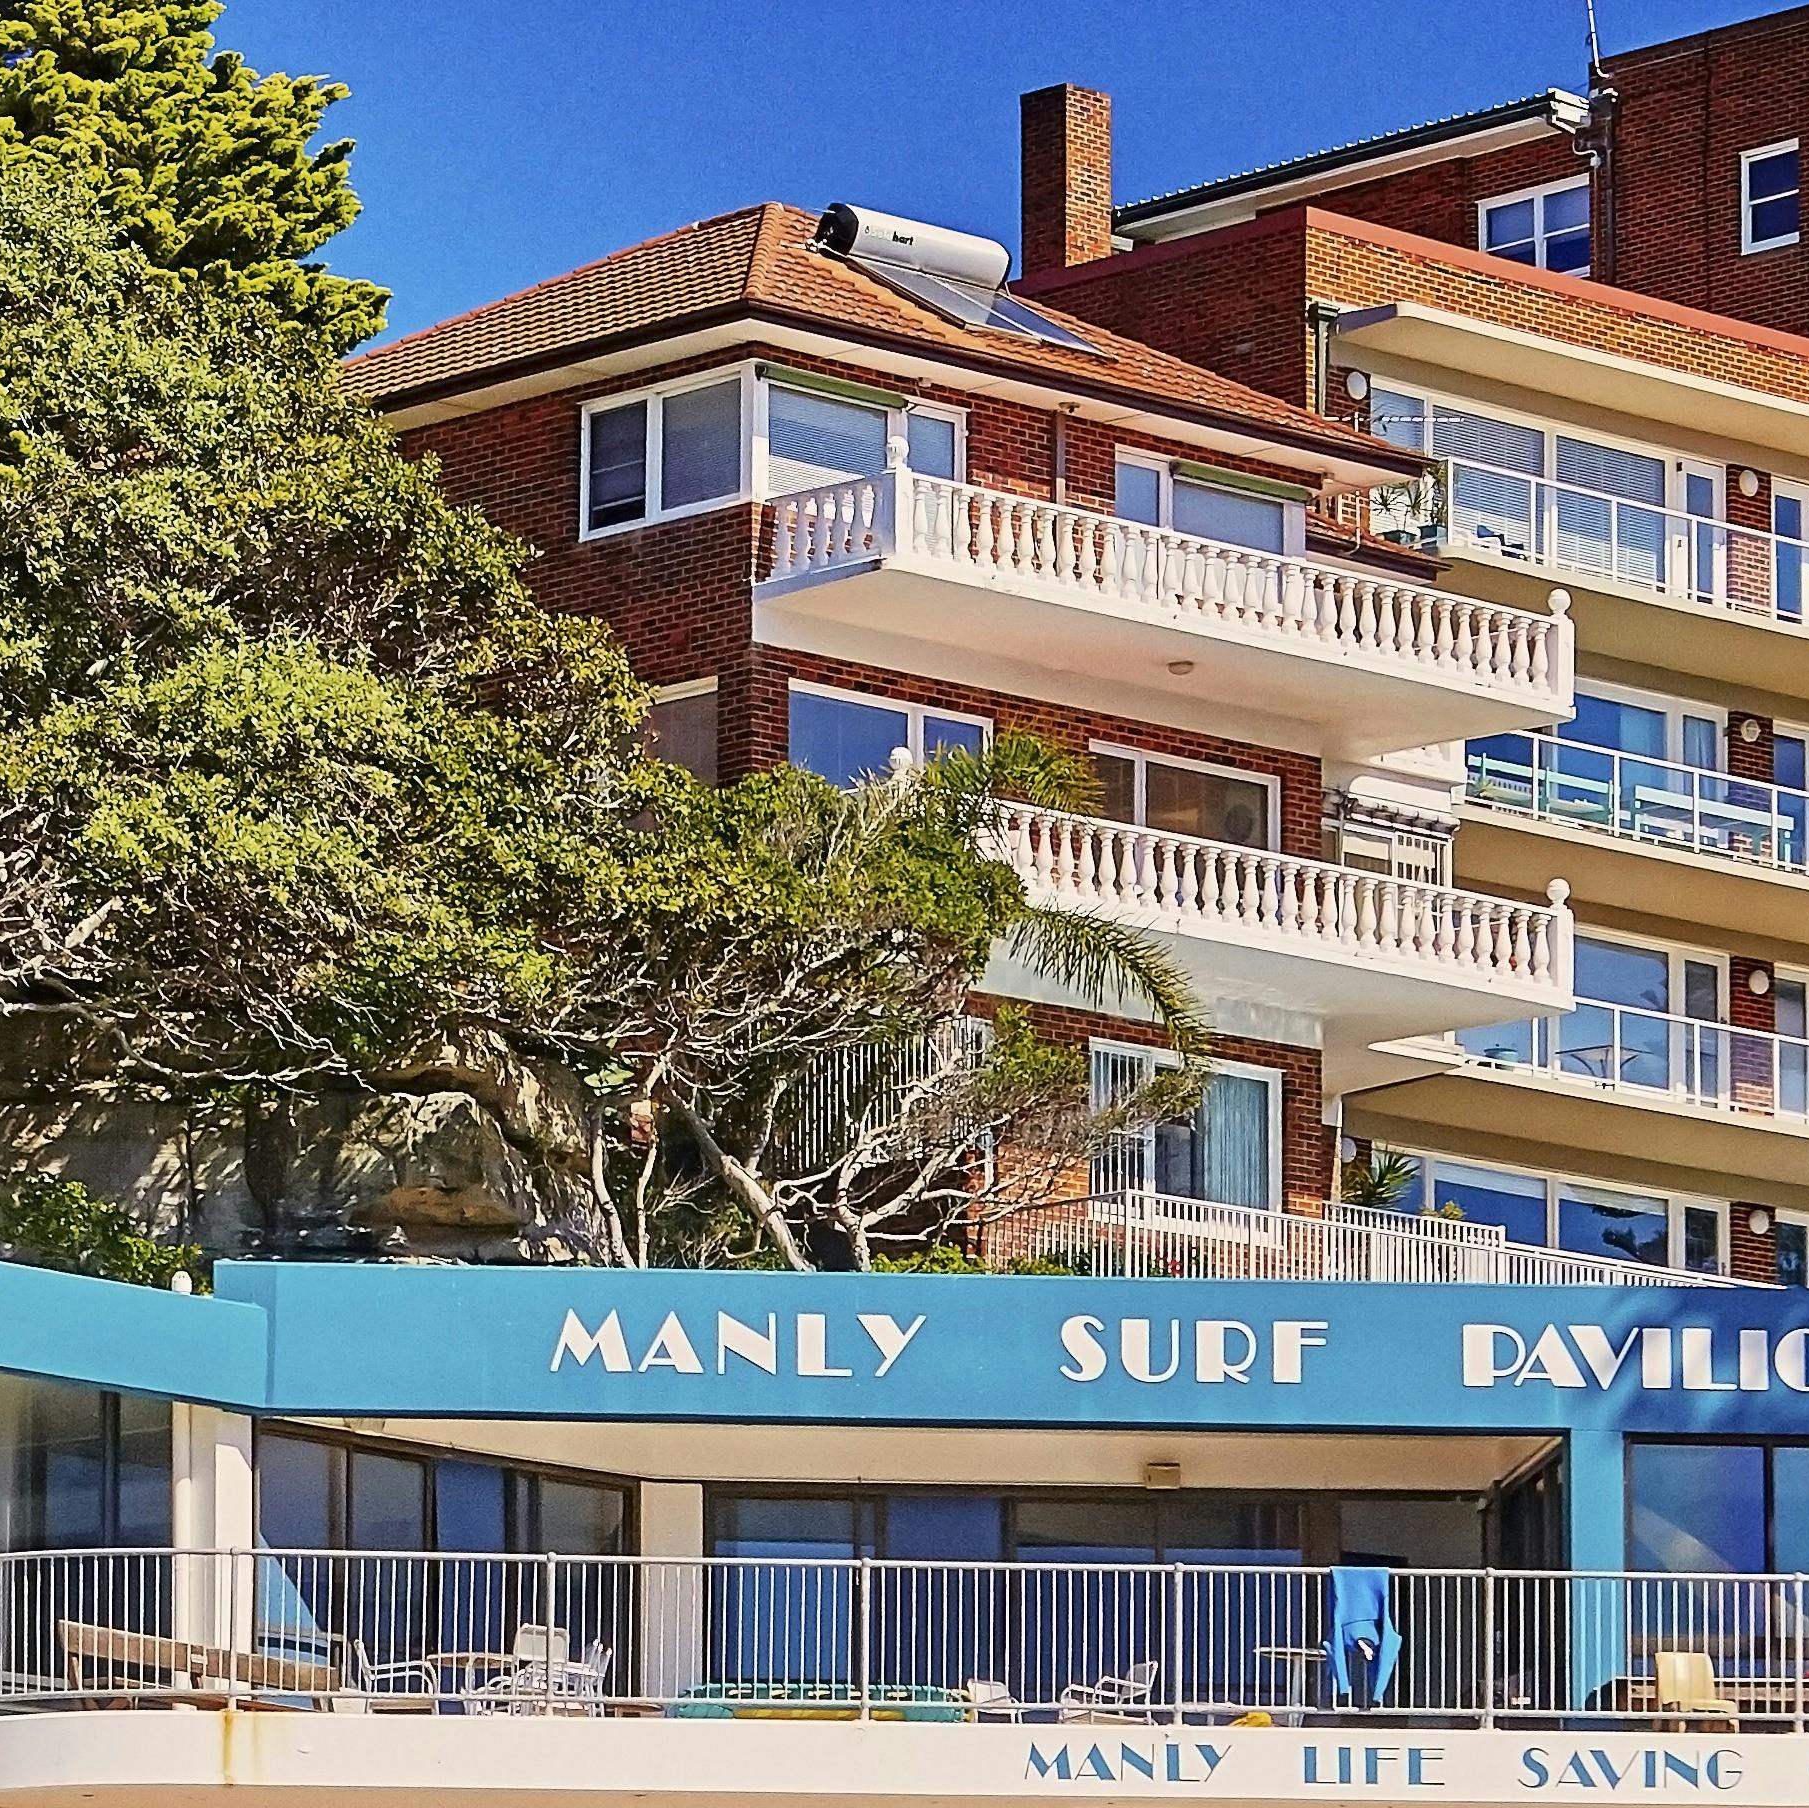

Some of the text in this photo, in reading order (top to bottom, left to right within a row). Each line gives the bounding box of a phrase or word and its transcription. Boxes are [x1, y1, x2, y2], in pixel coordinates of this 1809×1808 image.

[550, 1308, 927, 1377] MANLY
[1059, 1315, 1329, 1384] SURF
[1024, 1742, 1232, 1783] MANLY
[1302, 1746, 1446, 1786] LIFE
[1517, 1747, 1745, 1791] SAVING
